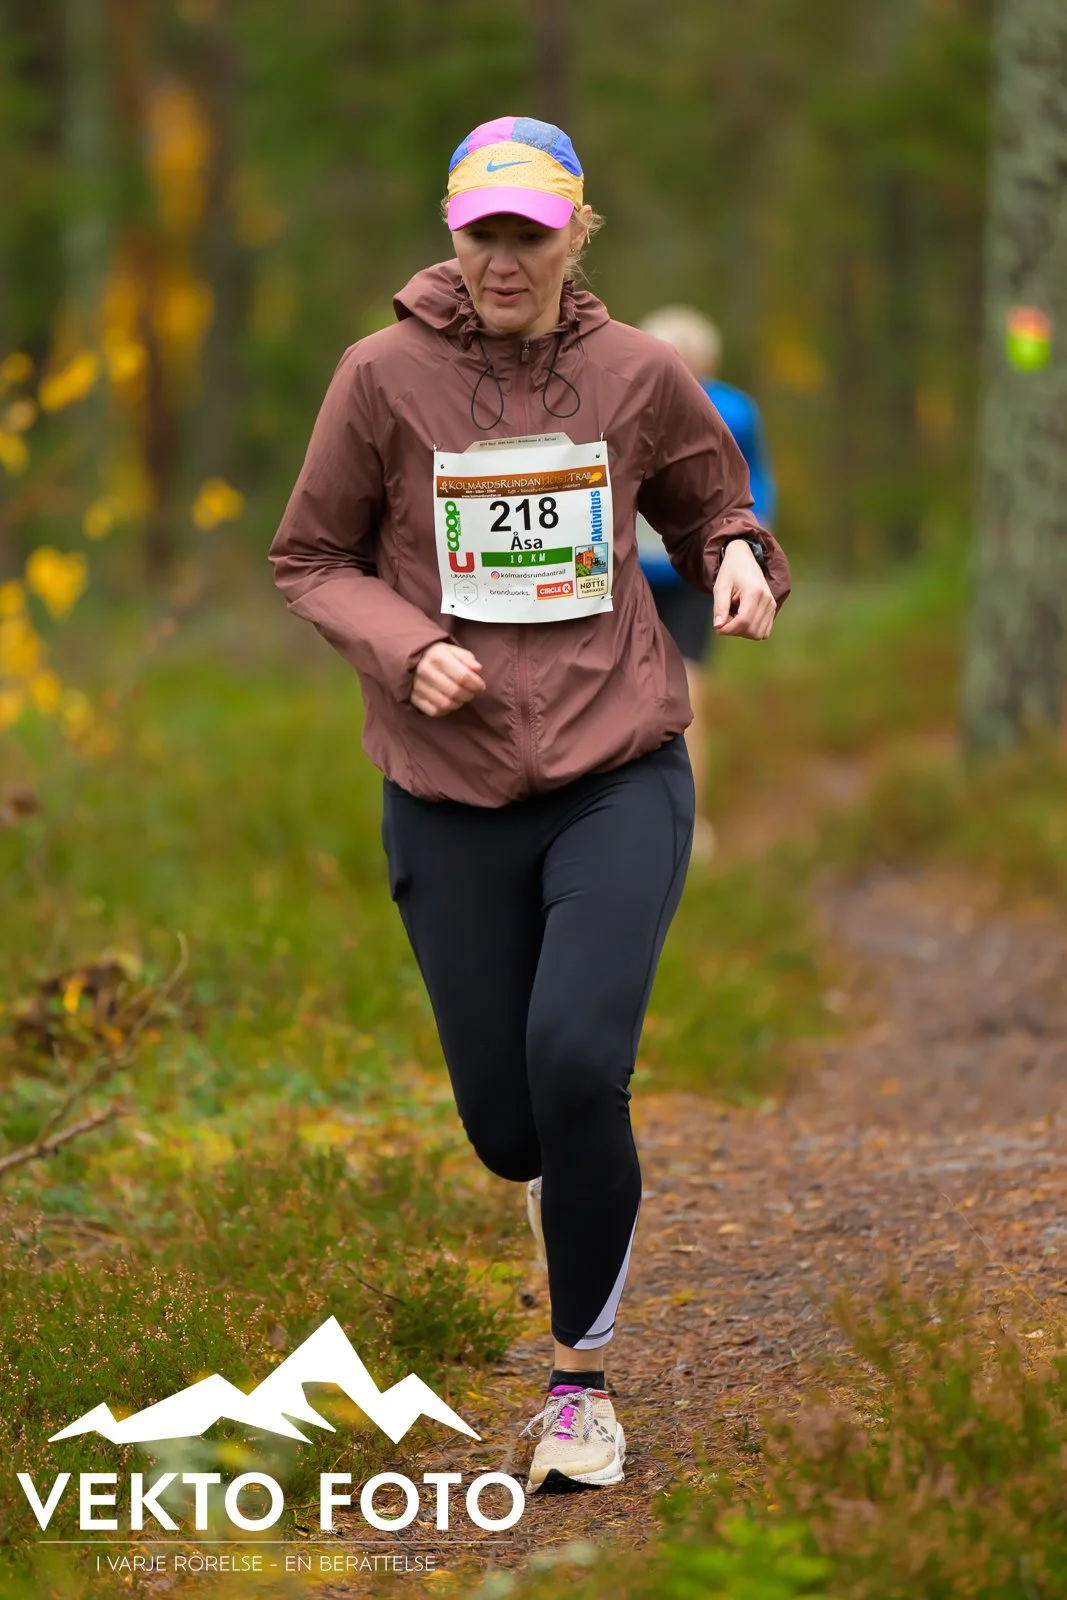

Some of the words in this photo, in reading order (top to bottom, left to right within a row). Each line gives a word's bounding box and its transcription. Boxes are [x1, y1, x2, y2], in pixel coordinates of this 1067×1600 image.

[489, 497, 559, 532] 218
[590, 490, 603, 541] Aktivitus
[445, 501, 460, 552] coop
[511, 531, 543, 550] Åsa
[510, 554, 523, 564] 10
[540, 587, 561, 595] CIRCLE
[580, 580, 605, 589] NØTTE
